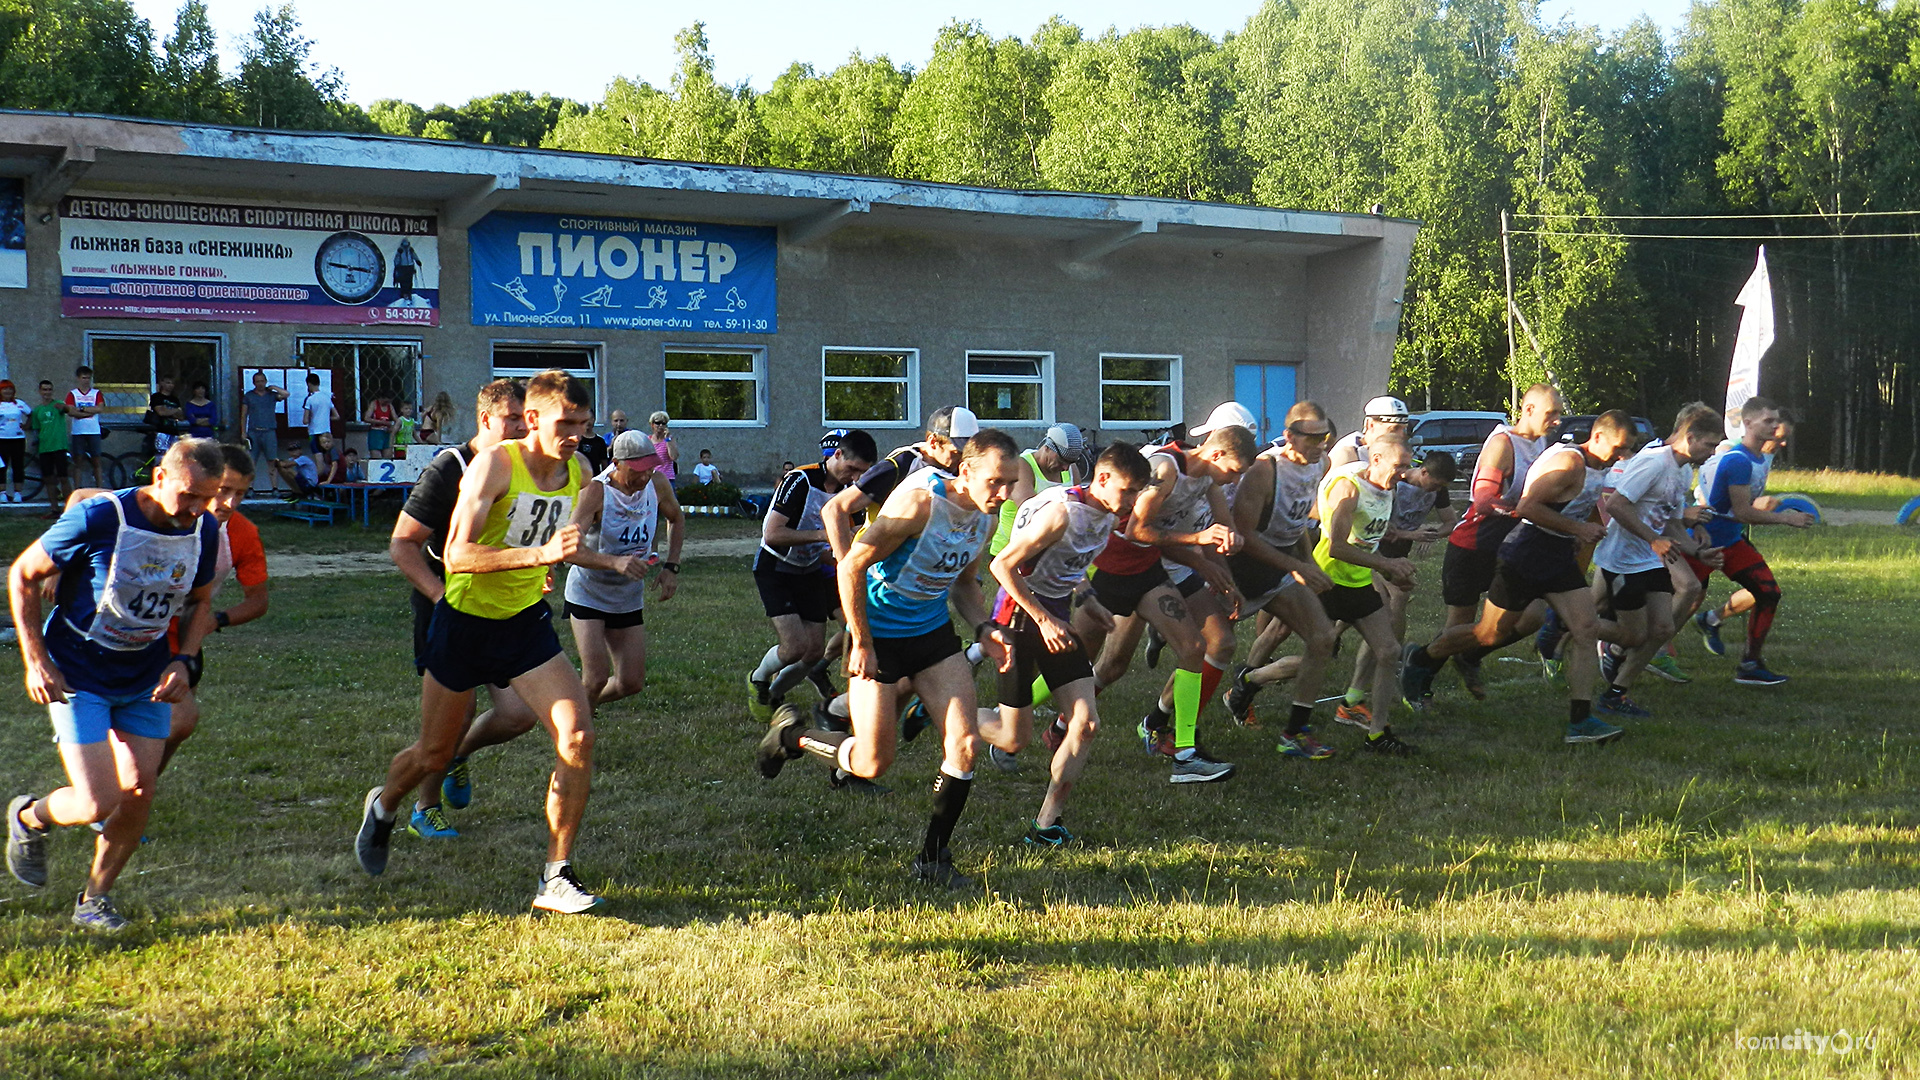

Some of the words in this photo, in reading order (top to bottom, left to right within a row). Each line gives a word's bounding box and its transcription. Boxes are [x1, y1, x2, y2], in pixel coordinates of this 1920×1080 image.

[69, 200, 240, 224] ДЕТСКО-ЮНОШЕСКАЯ
[244, 209, 344, 229] СПОРТИВНАЯ
[349, 214, 400, 232] ШКОЛА
[404, 219, 428, 233] №4
[559, 218, 640, 233] СПОРТИВНЫЙ
[644, 224, 697, 236] МАГАЗИН
[145, 237, 184, 255] база
[189, 240, 293, 259] «СНЕЖИНКА»
[517, 232, 737, 283] ПИОНЕР
[198, 285, 310, 300] ориентирование»
[385, 308, 431, 320] 54-30-72
[484, 312, 501, 323] ул.
[503, 311, 576, 326] Пионерская,
[580, 313, 591, 325] 11
[603, 315, 693, 328] www.pioner-dv.ru
[704, 319, 723, 329] тел.
[725, 318, 768, 330] 59-11-30
[379, 462, 396, 482] 2
[520, 499, 563, 546] 38
[128, 589, 175, 619] 425
